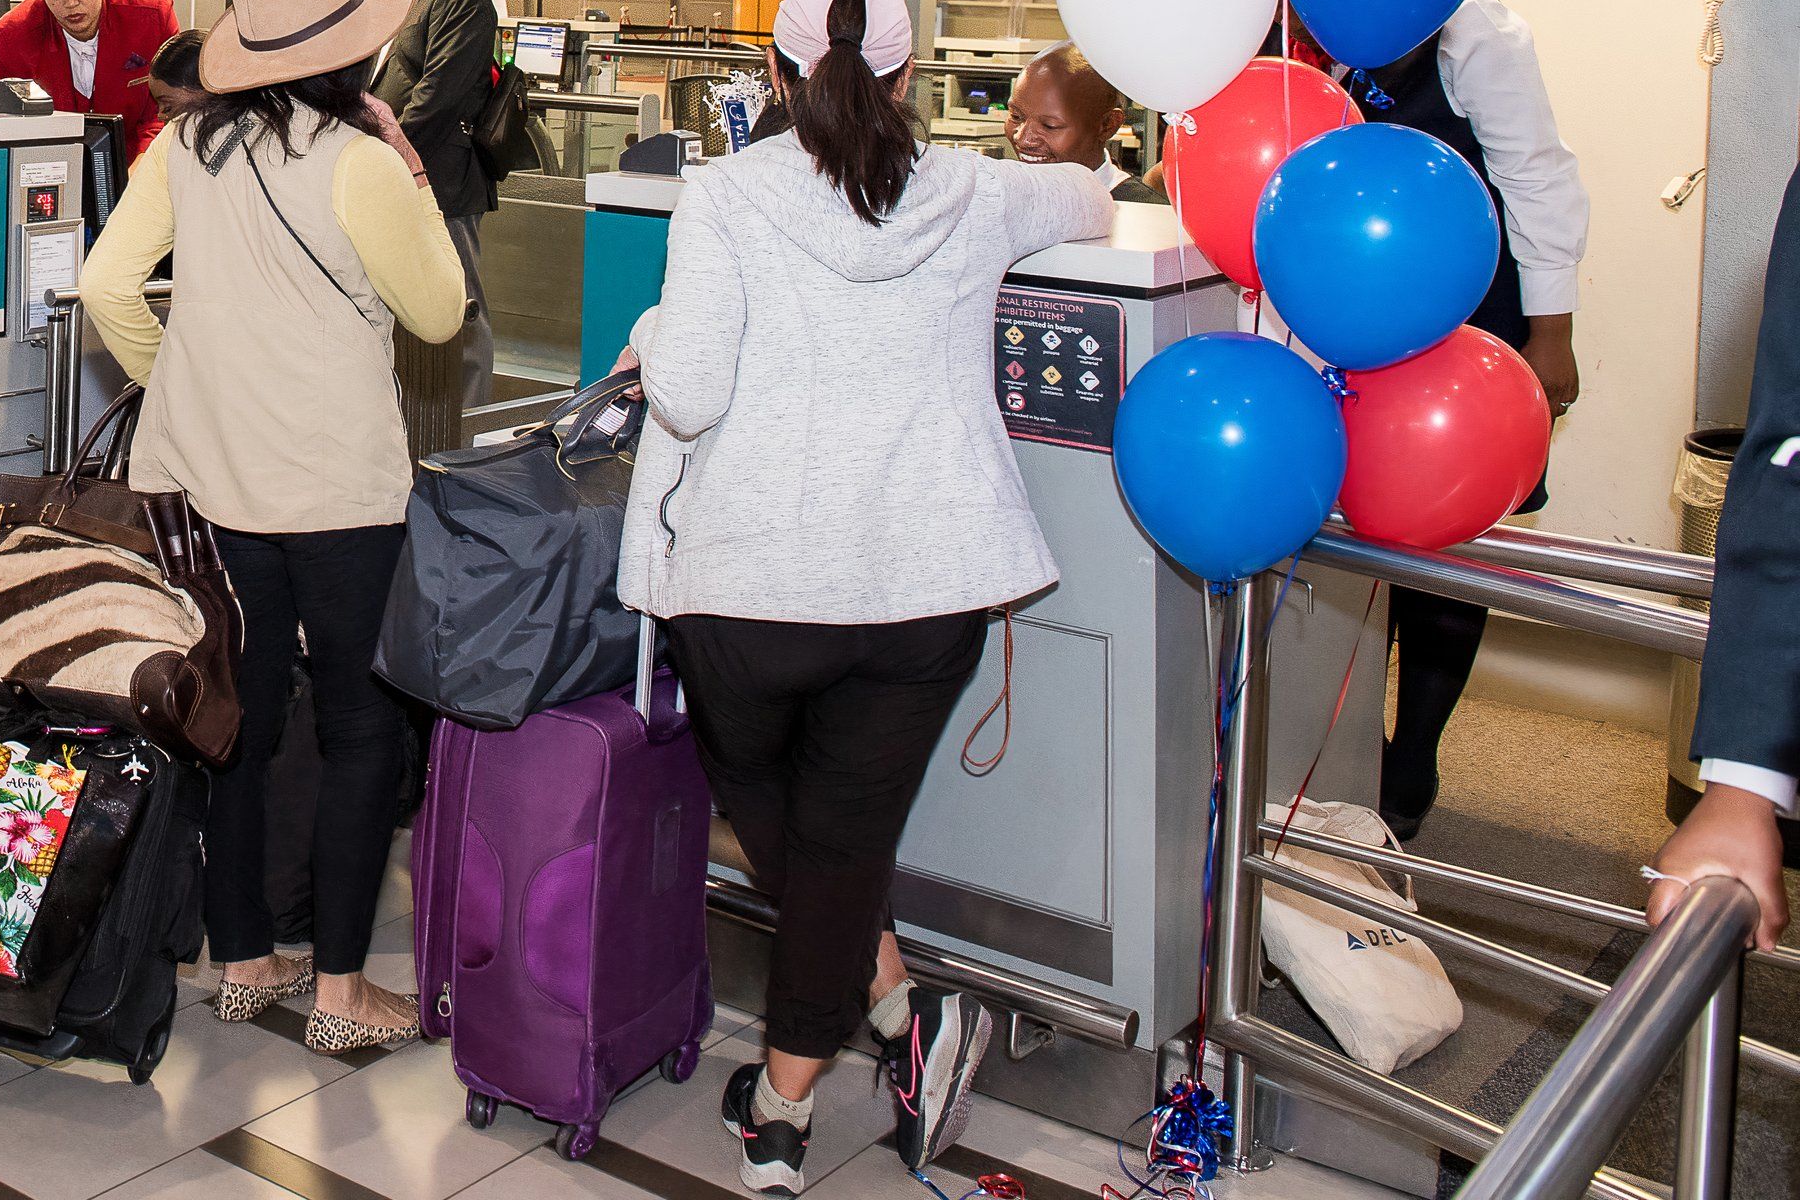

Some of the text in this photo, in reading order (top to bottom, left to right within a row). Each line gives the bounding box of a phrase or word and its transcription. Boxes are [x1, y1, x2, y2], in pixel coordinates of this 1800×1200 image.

[1022, 300, 1084, 313] RESTRICTION
[1038, 313, 1066, 321] ITEMS
[1013, 320, 1046, 329] permitted
[1055, 324, 1083, 334] baggage
[7, 777, 42, 788] Aloha
[1366, 927, 1408, 949] DEL
